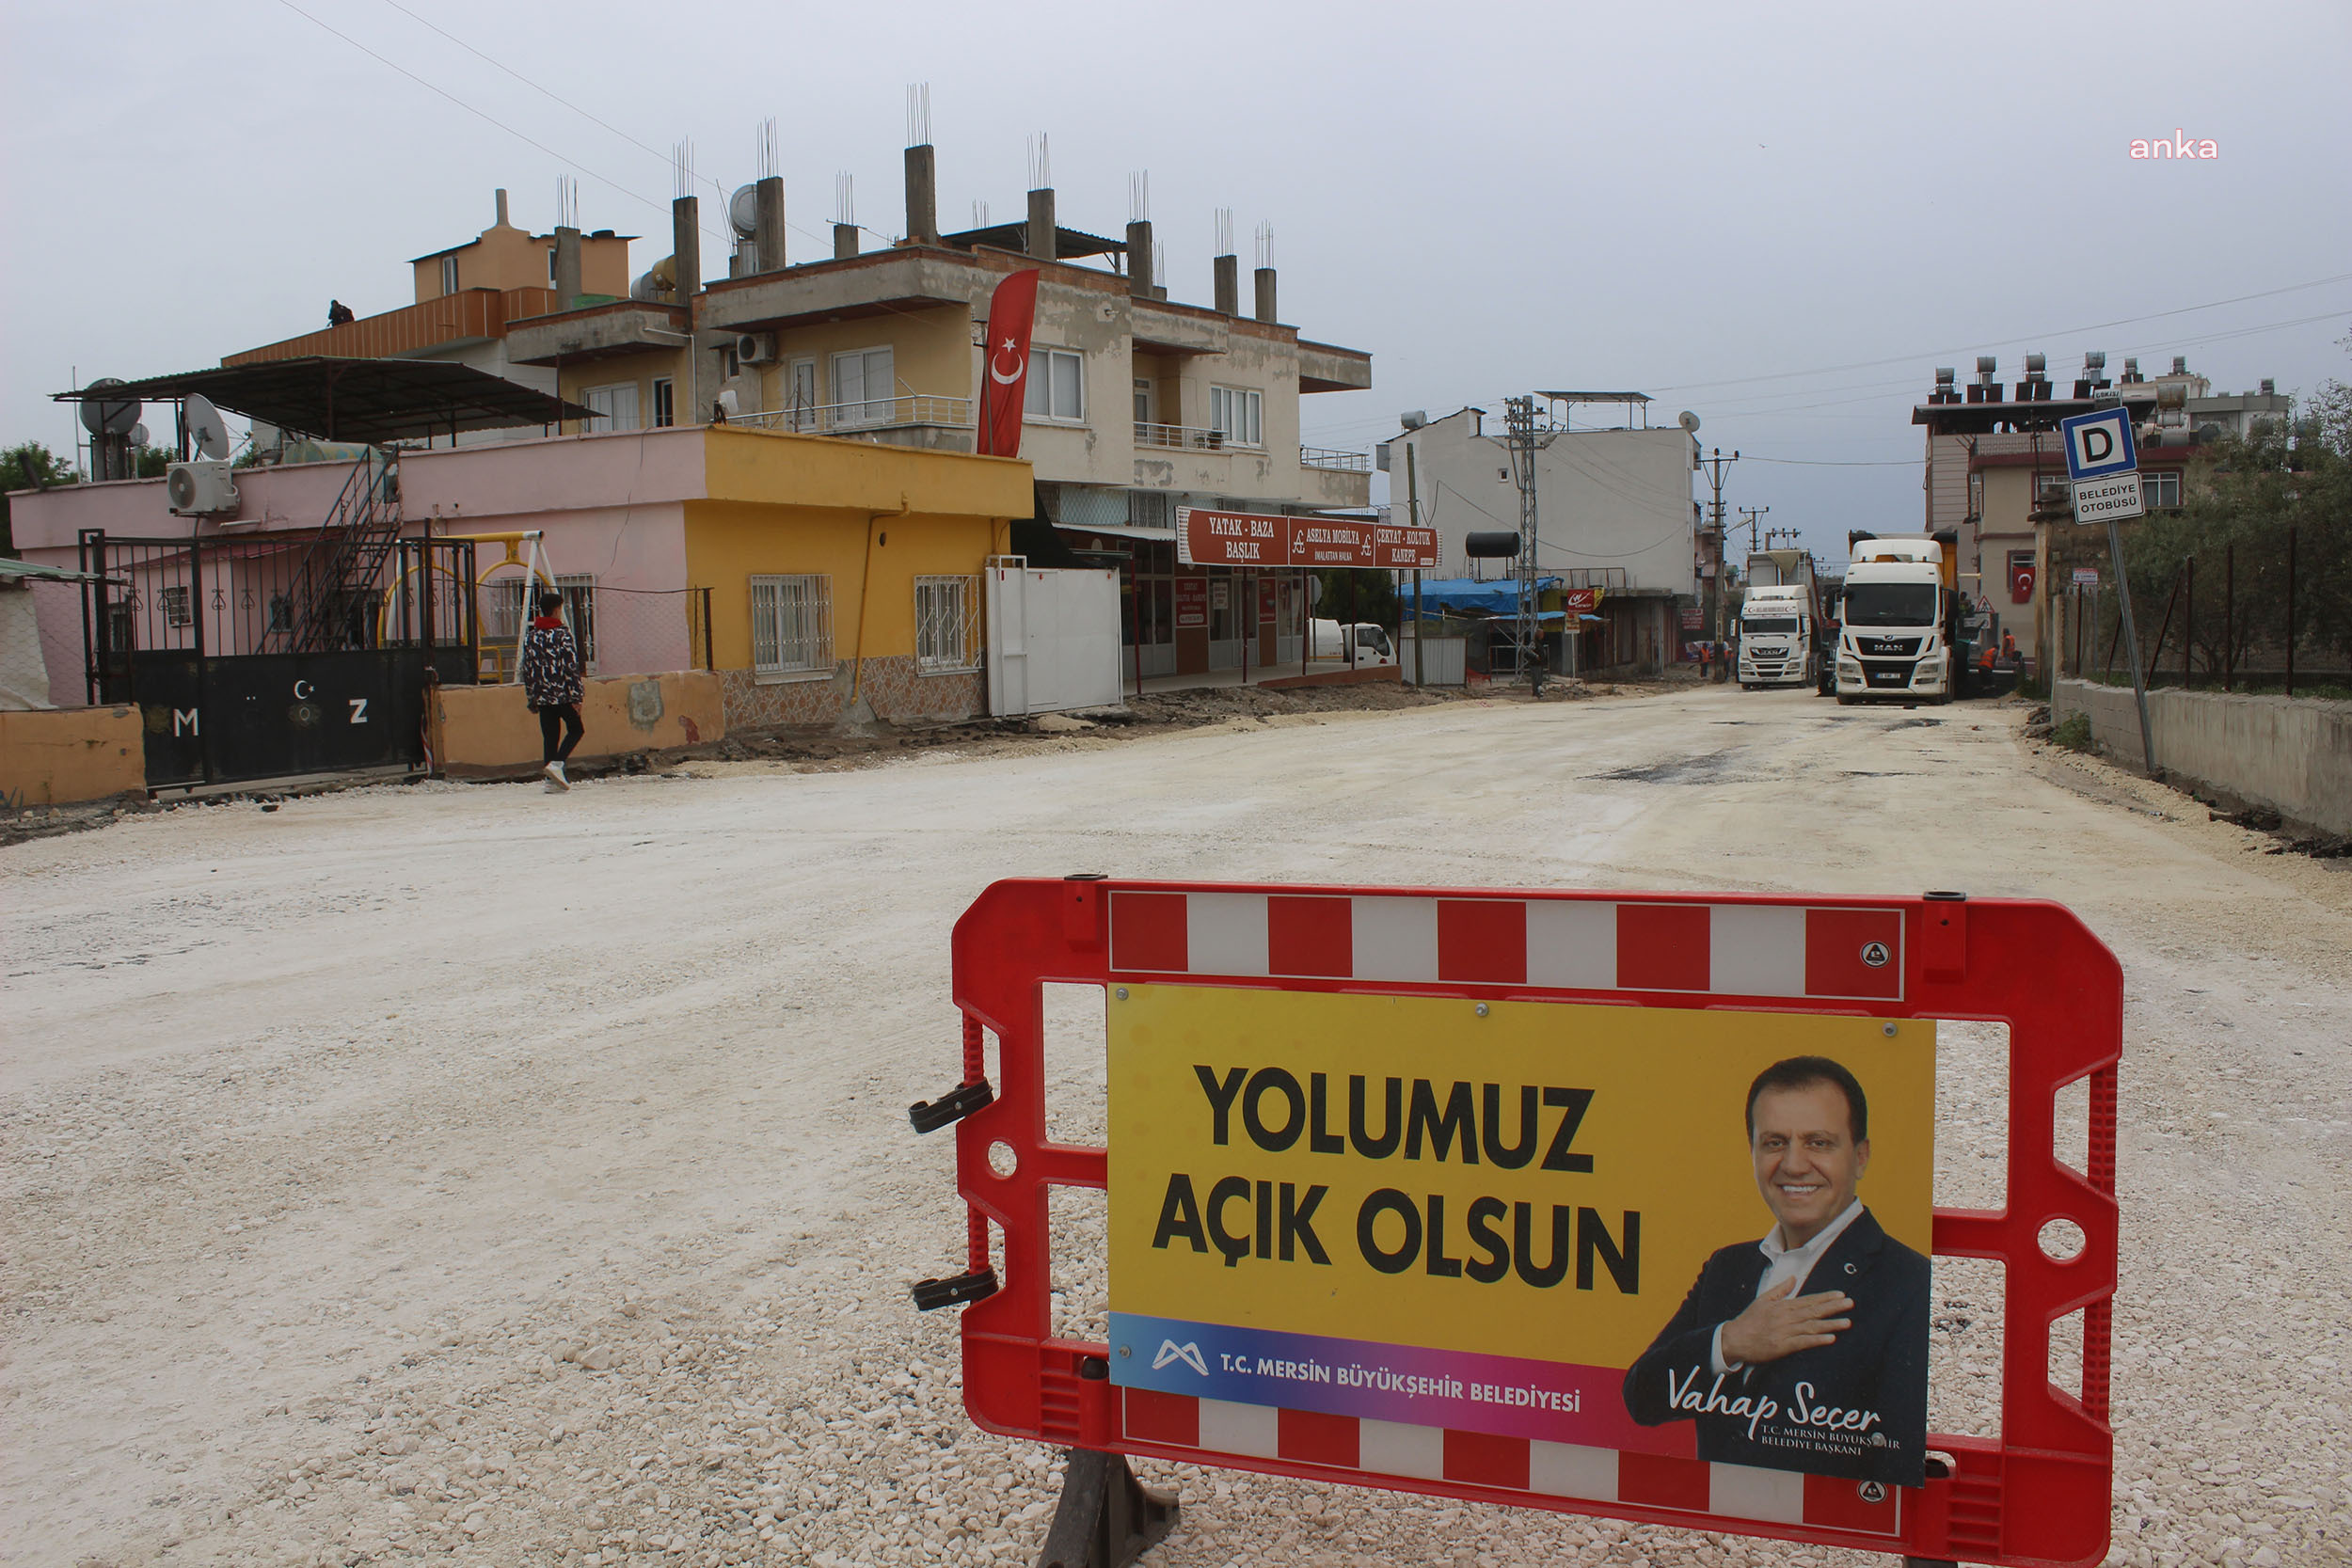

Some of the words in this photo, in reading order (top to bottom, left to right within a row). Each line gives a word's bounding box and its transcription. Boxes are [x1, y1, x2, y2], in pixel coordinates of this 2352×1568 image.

[2081, 427, 2113, 463] D
[2079, 483, 2137, 501] BELEDİYE
[2080, 496, 2137, 514] OTOBÜSÜ
[1209, 516, 1243, 536] YATAK
[1250, 519, 1275, 538] BAZA
[1306, 528, 1332, 544] ASELYA
[1332, 527, 1360, 546] MOBİLYA
[1376, 528, 1402, 547] ÇEKYAT
[1406, 531, 1431, 546] KOLTUK
[1226, 541, 1261, 563] BAŞLIK
[1391, 547, 1417, 563] KANEPE
[1874, 643, 1903, 652] MAN
[1192, 1064, 1596, 1174] YOLUMUZ
[1152, 1172, 1333, 1268] AÇIK
[1356, 1187, 1641, 1295] OLSUN
[1220, 1354, 1252, 1374] T.C.
[1257, 1358, 1330, 1384] MERSİN
[1337, 1364, 1464, 1399] BÜYÜKŞEHİR
[1470, 1384, 1581, 1413] BELEDİYESİ
[1668, 1365, 1778, 1441] Vahap
[1788, 1381, 1882, 1431] Seçer
[1761, 1424, 1781, 1435] T.C.
[1784, 1427, 1826, 1440] MERSİN
[1761, 1435, 1812, 1449] BELEDİYE
[1815, 1442, 1862, 1456] BAŞKANI
